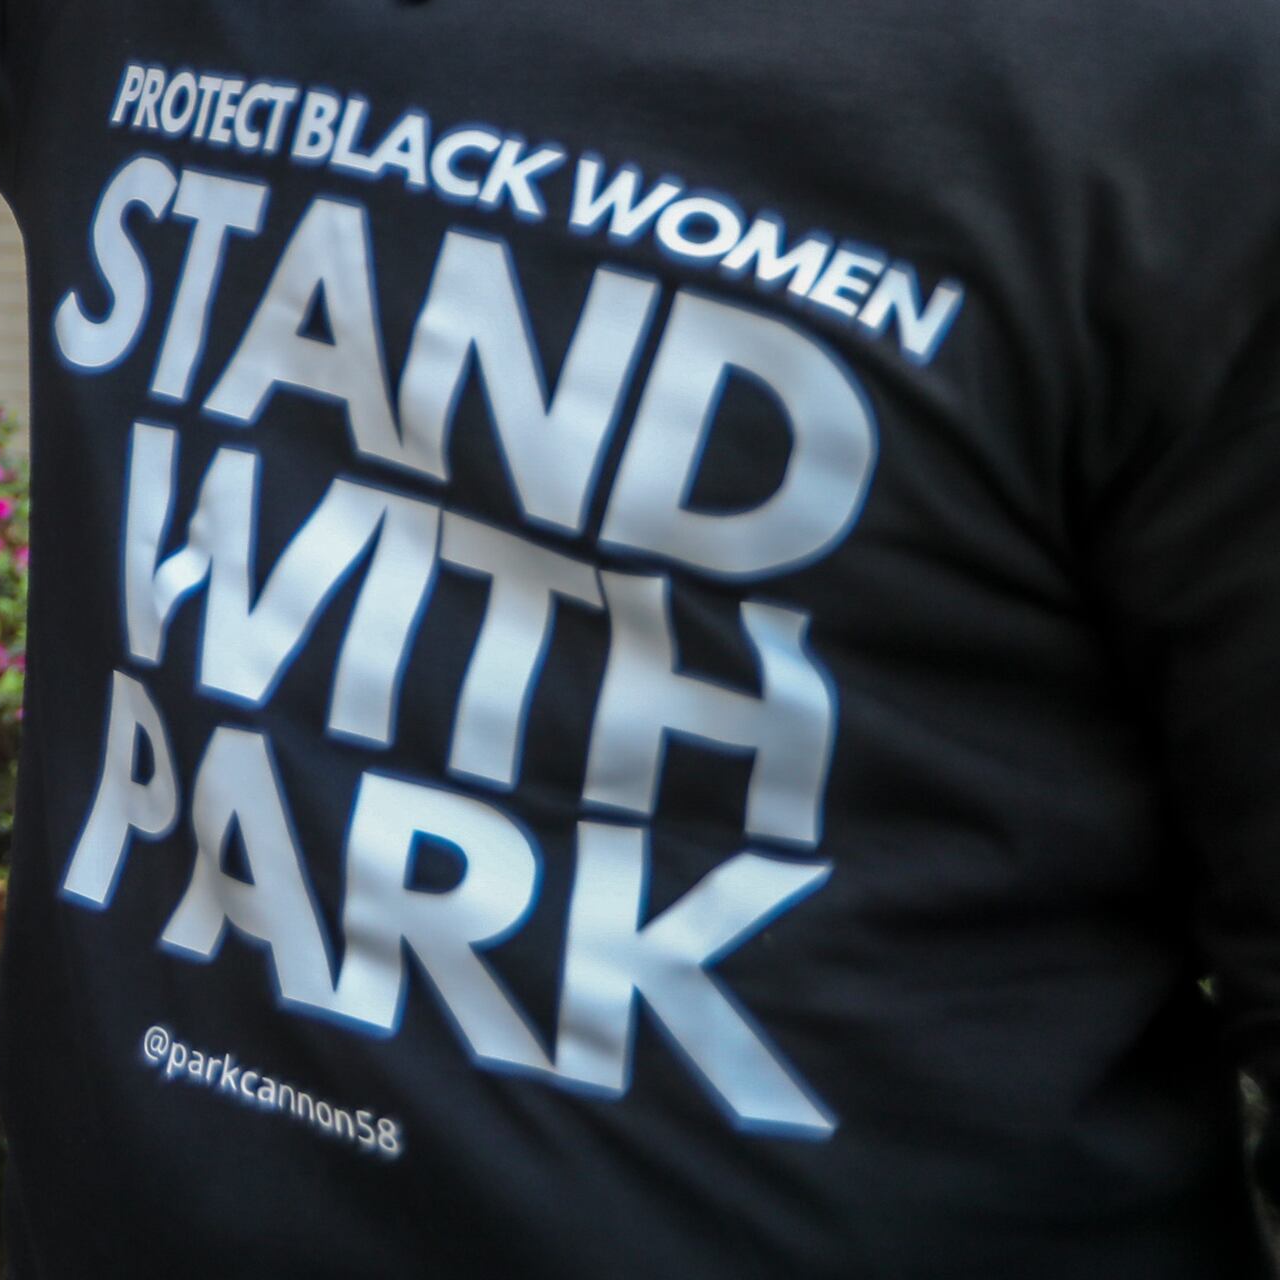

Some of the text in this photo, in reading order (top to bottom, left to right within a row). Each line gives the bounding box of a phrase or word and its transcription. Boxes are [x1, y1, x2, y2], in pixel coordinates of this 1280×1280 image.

[54, 155, 880, 578] STAND
[111, 65, 964, 357] PROTECT BLACK WOMEN
[125, 422, 835, 848] WITH
[60, 669, 835, 1138] PARK
[143, 1025, 400, 1154] @parkcannon58
